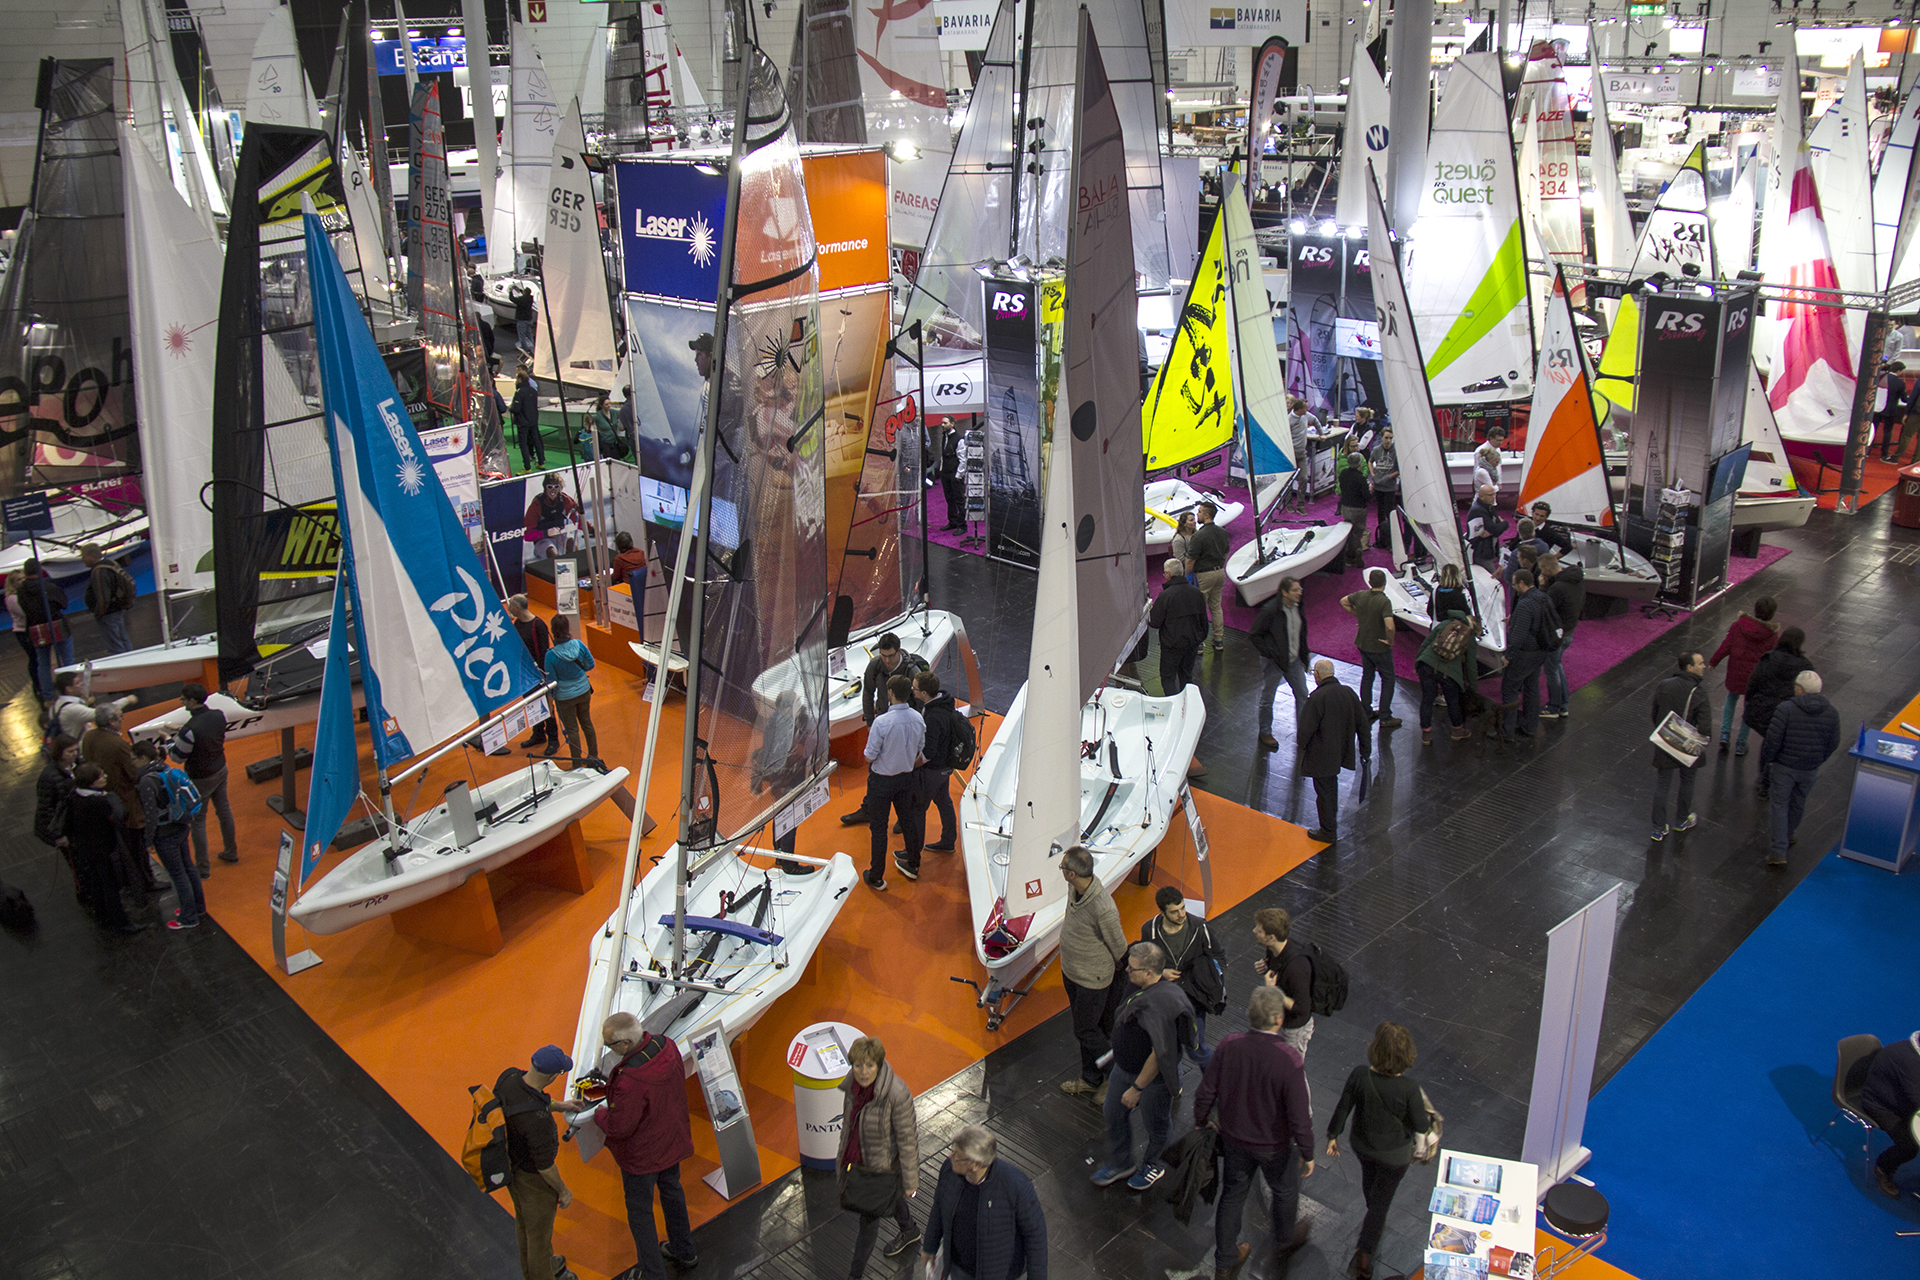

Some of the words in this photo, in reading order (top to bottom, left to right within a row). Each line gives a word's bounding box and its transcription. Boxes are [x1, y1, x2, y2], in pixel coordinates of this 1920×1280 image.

[943, 14, 991, 28] BAVARIA
[1237, 8, 1282, 22] BAVARIA
[1521, 110, 1566, 124] BAZE
[424, 186, 446, 204] GER
[551, 187, 586, 212] GER
[1433, 185, 1495, 205] Quest
[635, 208, 688, 239] Laser
[1299, 245, 1334, 263] RS
[1353, 249, 1371, 267] R
[1043, 286, 1057, 295] RS
[992, 290, 1026, 313] RS
[1655, 310, 1706, 332] RS
[1727, 307, 1749, 333] RS
[1862, 326, 1887, 414] HARTLEY
[936, 382, 969, 397] RS
[377, 397, 415, 458] Laser
[423, 435, 450, 447] Laser
[1851, 421, 1871, 480] BOATS
[492, 527, 527, 543] Laser
[429, 565, 511, 698] Pico
